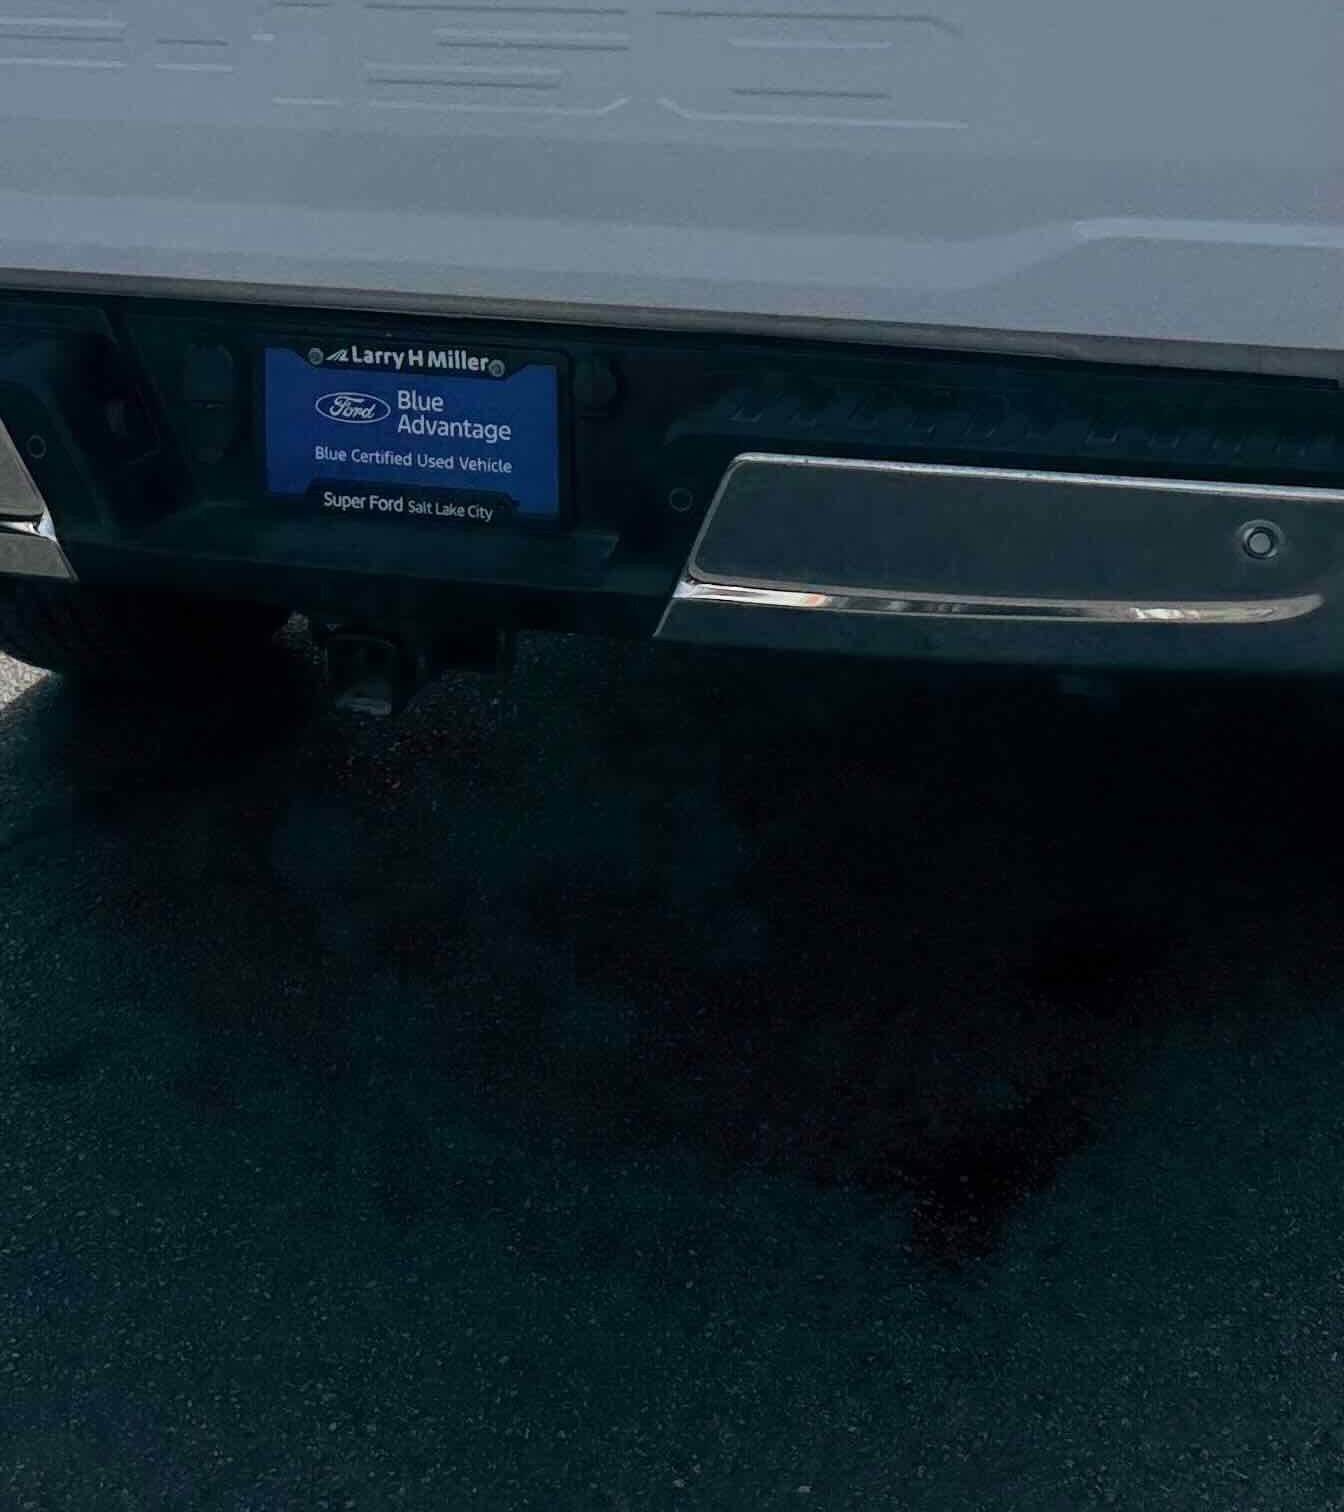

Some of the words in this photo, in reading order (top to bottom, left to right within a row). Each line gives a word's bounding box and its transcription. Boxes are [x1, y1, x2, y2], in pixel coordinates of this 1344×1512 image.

[352, 346, 404, 371] Larry
[408, 349, 424, 367] H
[427, 350, 488, 372] Miller
[328, 395, 376, 420] Ford
[397, 390, 444, 413] Blue
[397, 414, 512, 444] Advantage
[314, 445, 347, 462] Blue
[351, 448, 413, 467] Certified
[417, 454, 455, 470] Used
[458, 457, 513, 473] Vehicle
[323, 491, 366, 511] Super
[369, 495, 404, 512] Ford
[408, 500, 433, 515] Salt
[435, 502, 465, 518] Lake
[467, 505, 494, 522] City
